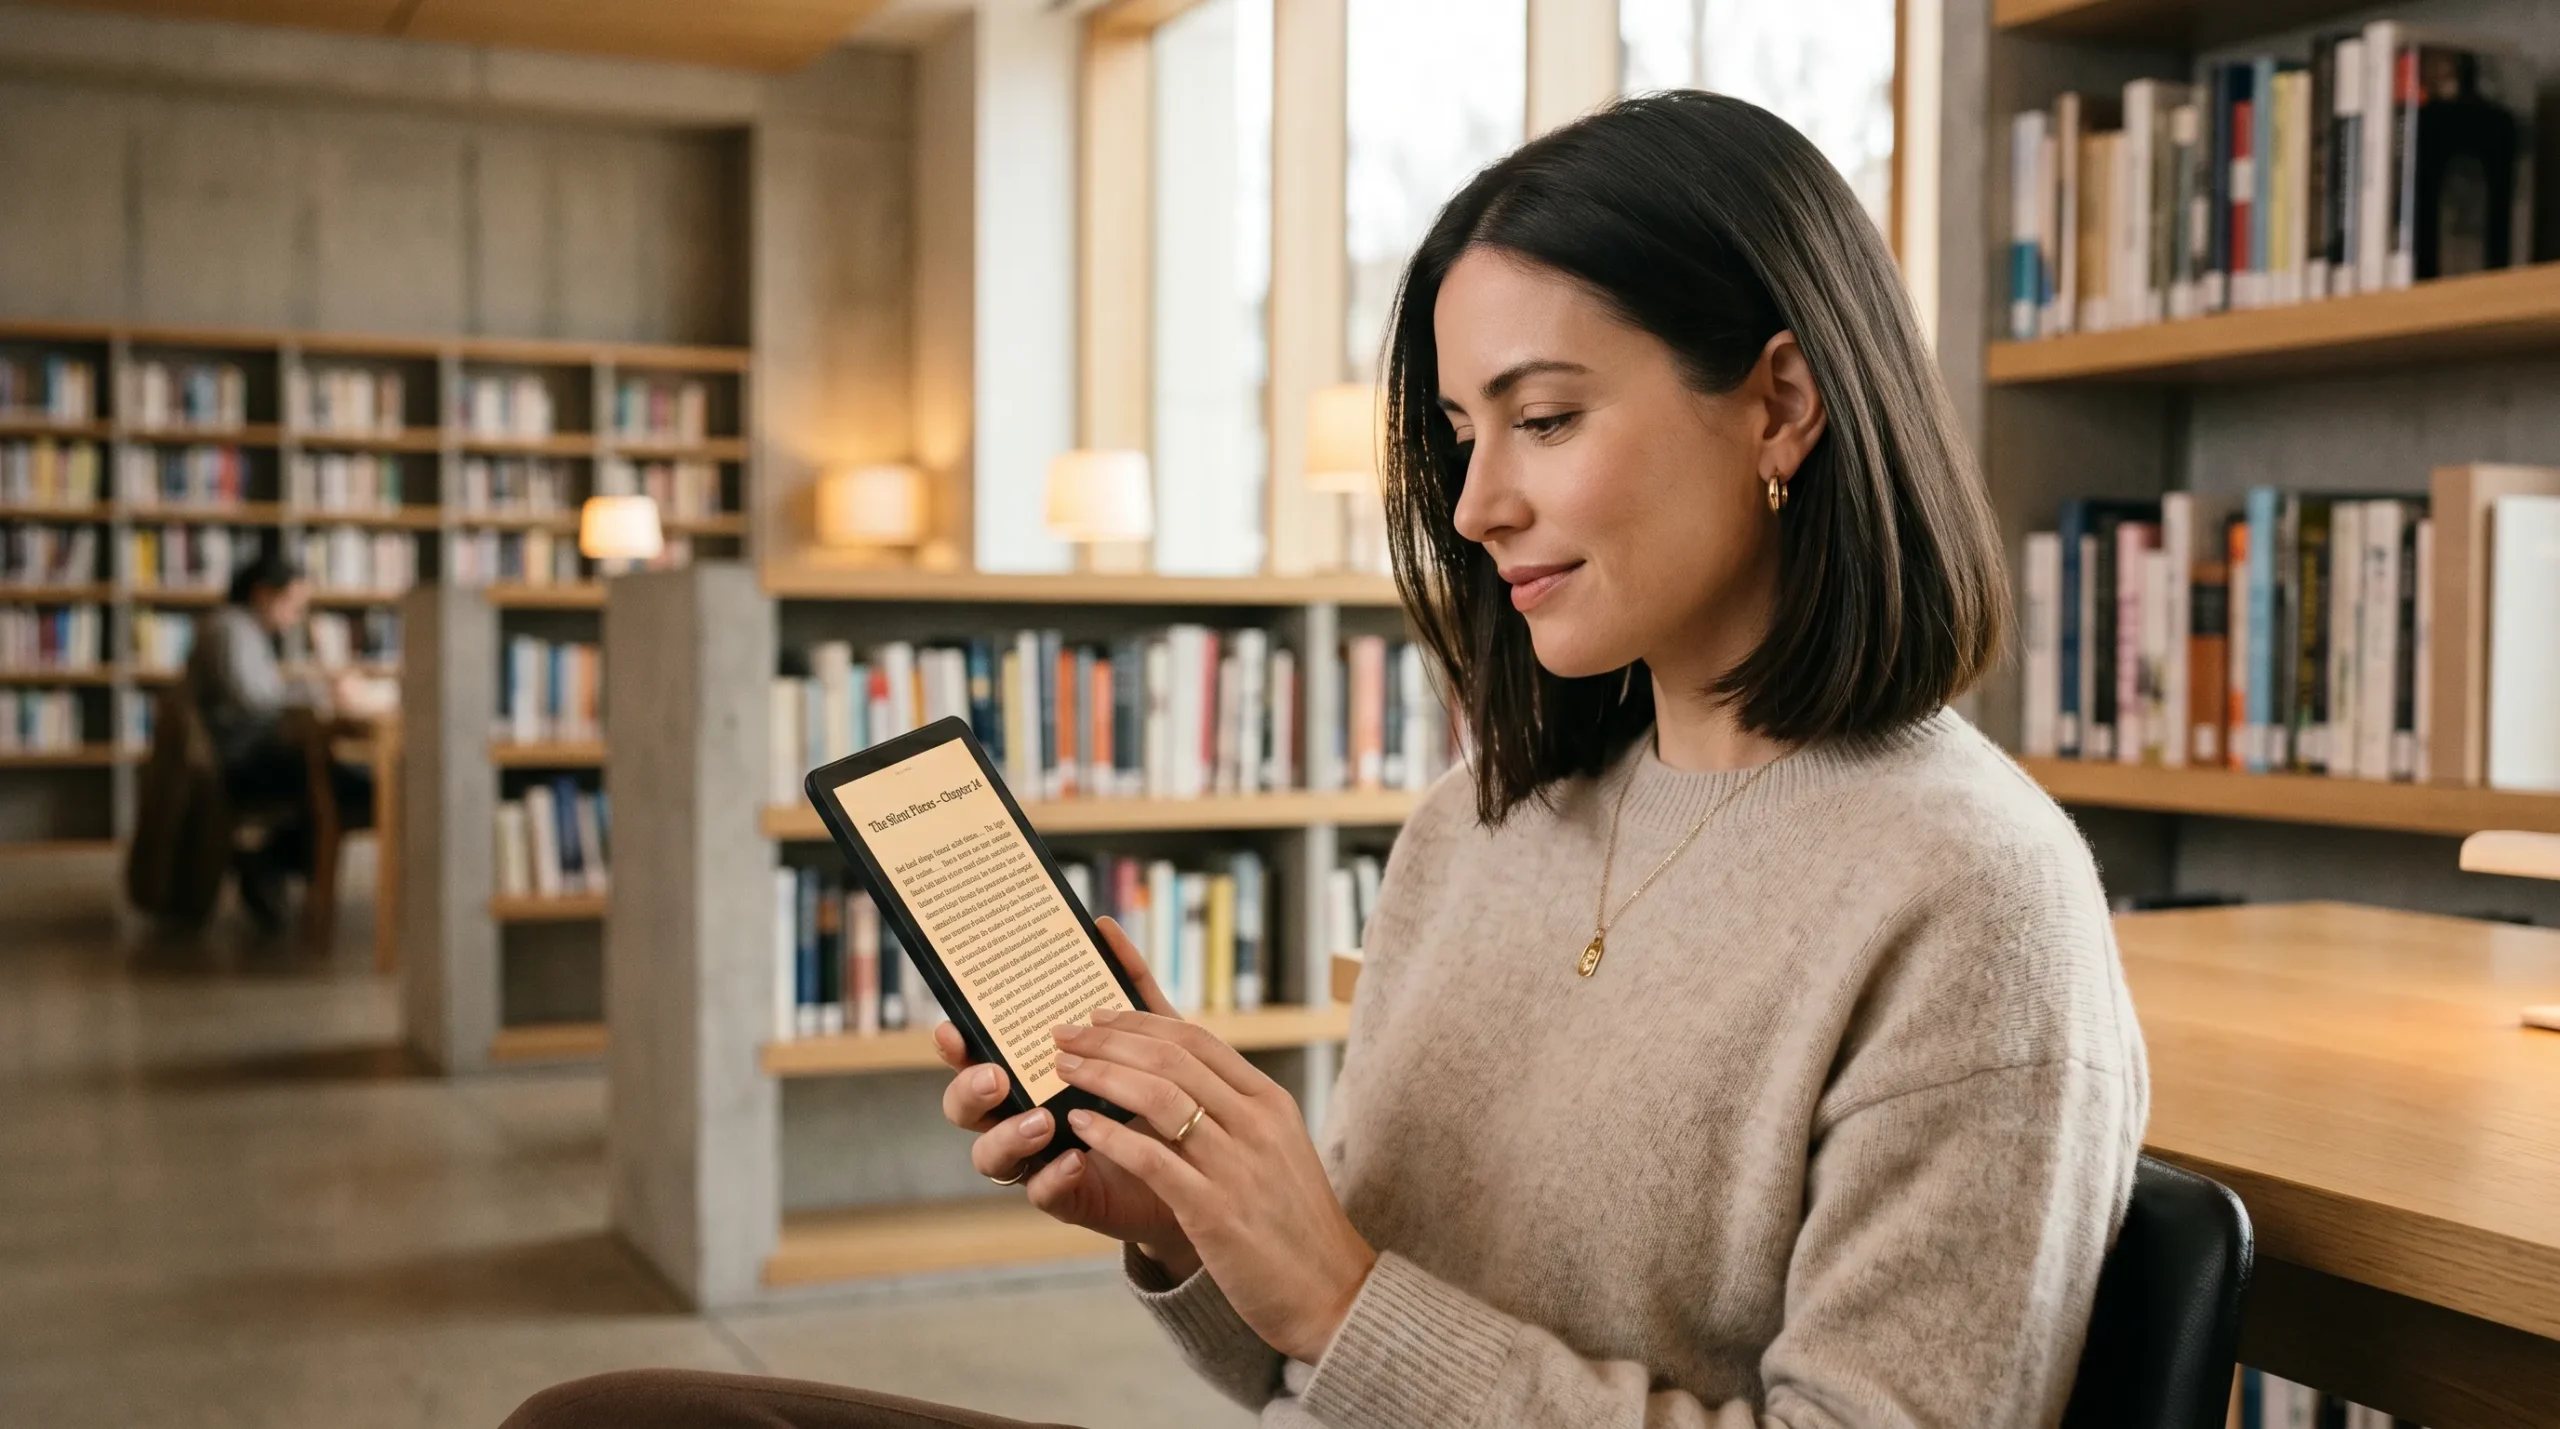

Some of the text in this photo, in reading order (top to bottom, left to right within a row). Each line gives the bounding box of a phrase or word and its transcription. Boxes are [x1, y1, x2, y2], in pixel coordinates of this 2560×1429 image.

[868, 820, 888, 833] The
[886, 809, 911, 826] Silent
[909, 799, 937, 816] Places
[940, 785, 973, 803] Chapter
